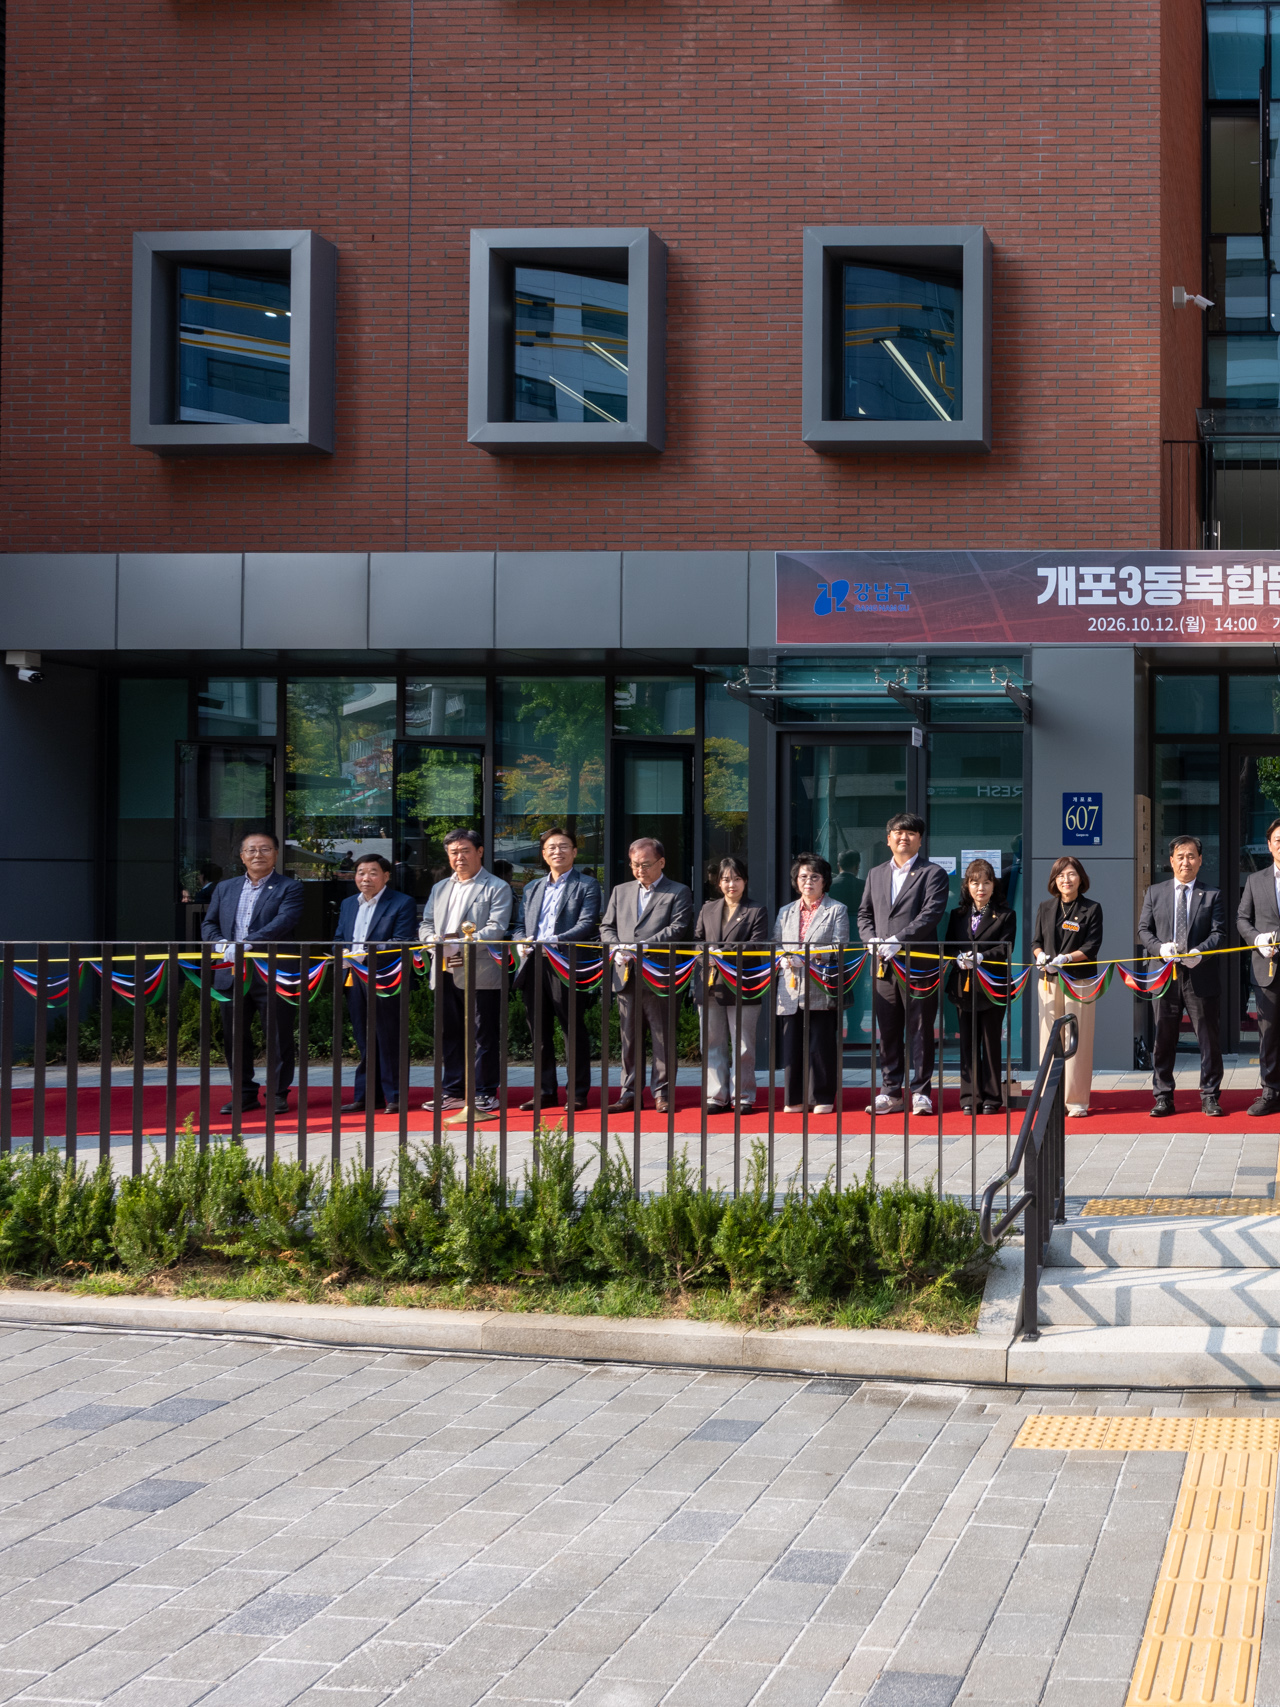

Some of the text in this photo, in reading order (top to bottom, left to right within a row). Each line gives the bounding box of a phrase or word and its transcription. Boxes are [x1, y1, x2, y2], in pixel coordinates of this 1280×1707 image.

[853, 582, 911, 602] 강남구
[854, 604, 878, 612] GANG
[878, 604, 897, 612] NAM
[1087, 616, 1206, 634] 2026.10.12.(월)
[1214, 617, 1258, 631] 14:00
[1065, 805, 1099, 831] 607
